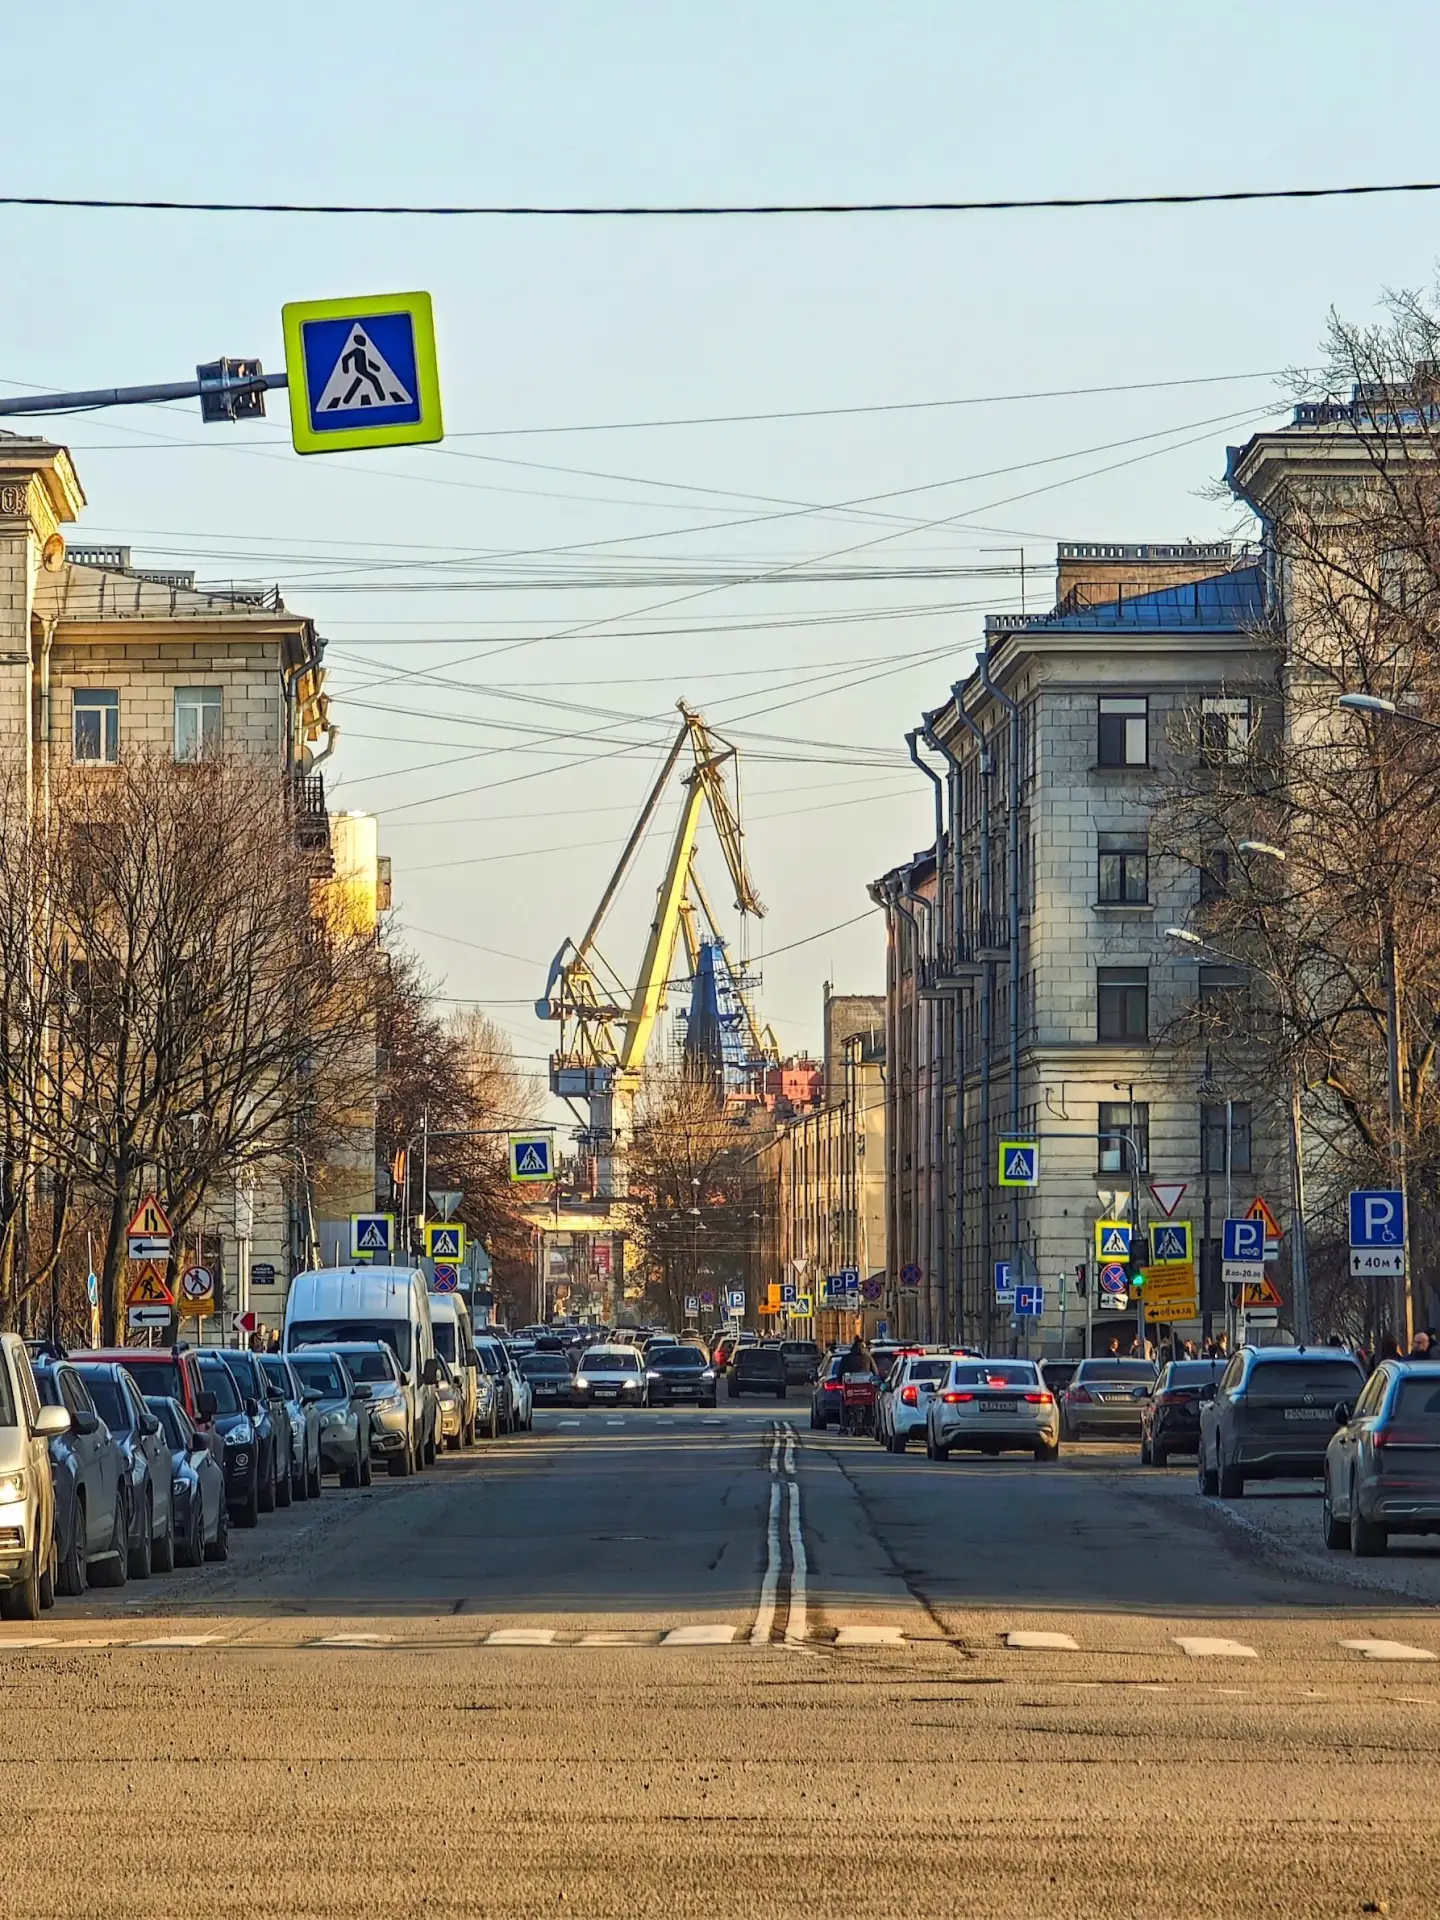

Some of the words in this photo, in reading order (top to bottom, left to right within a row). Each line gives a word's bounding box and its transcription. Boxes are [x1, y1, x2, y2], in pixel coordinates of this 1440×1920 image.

[1365, 1197, 1394, 1240] P
[1234, 1224, 1257, 1256] P
[845, 1273, 855, 1288] P
[1225, 1268, 1261, 1278] 8.00-20.00
[832, 1278, 843, 1294] P
[733, 1293, 743, 1306] P
[784, 1286, 794, 1302] P
[688, 1298, 697, 1309] P
